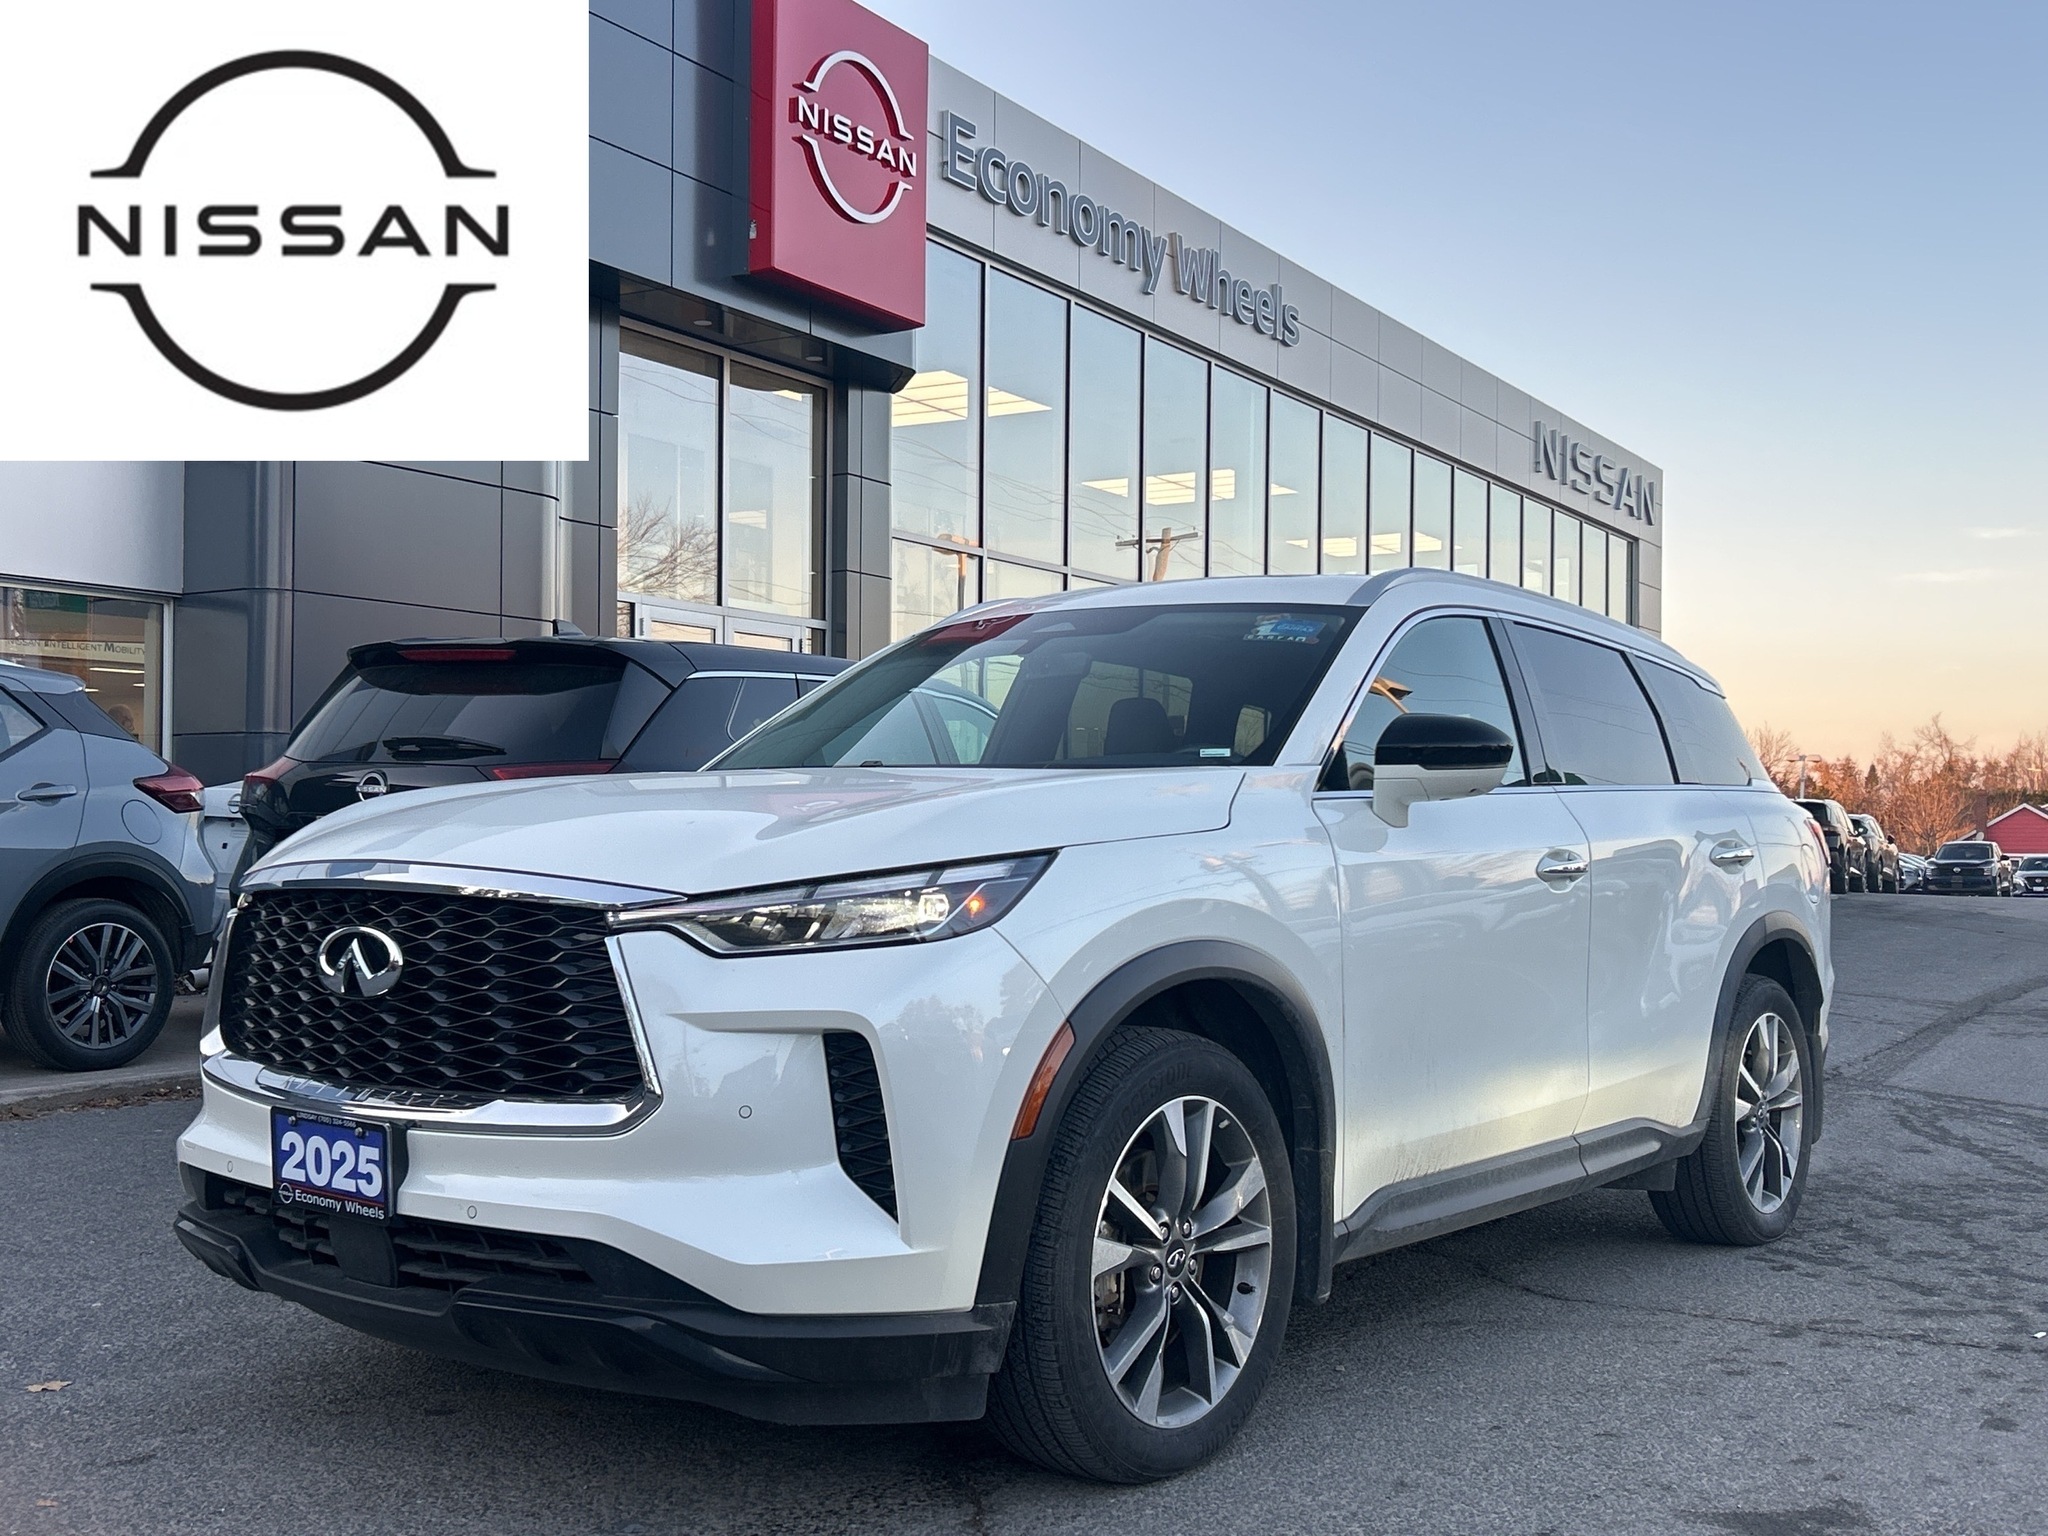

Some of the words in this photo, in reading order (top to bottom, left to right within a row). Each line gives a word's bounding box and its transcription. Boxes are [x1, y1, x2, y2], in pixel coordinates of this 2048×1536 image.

[795, 95, 917, 177] NISSAN
[942, 110, 1168, 295] Economy
[1170, 232, 1301, 347] Wheels
[1535, 421, 1656, 526] NISSAN
[281, 1131, 383, 1198] 2025
[295, 1190, 342, 1212] Economy
[345, 1201, 385, 1220] Wheels
